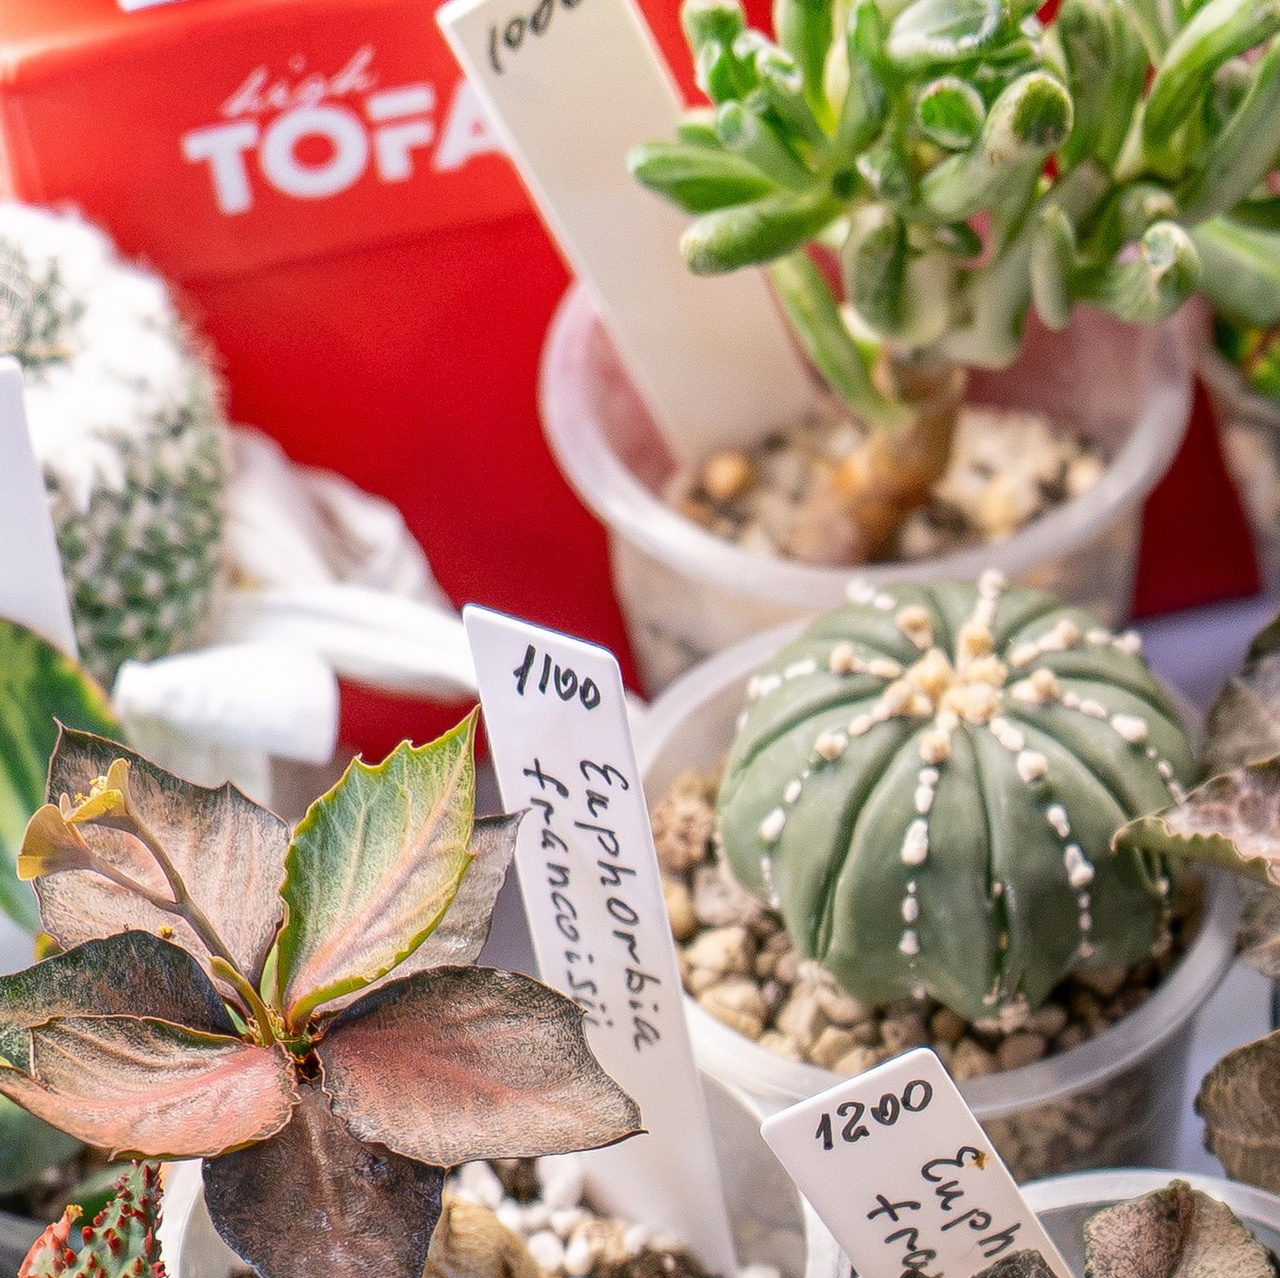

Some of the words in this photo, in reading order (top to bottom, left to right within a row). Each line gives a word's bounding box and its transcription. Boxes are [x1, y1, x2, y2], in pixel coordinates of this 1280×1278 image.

[513, 644, 601, 711] 1100
[580, 759, 661, 1051] Euphorbia
[815, 1079, 933, 1151] 1200
